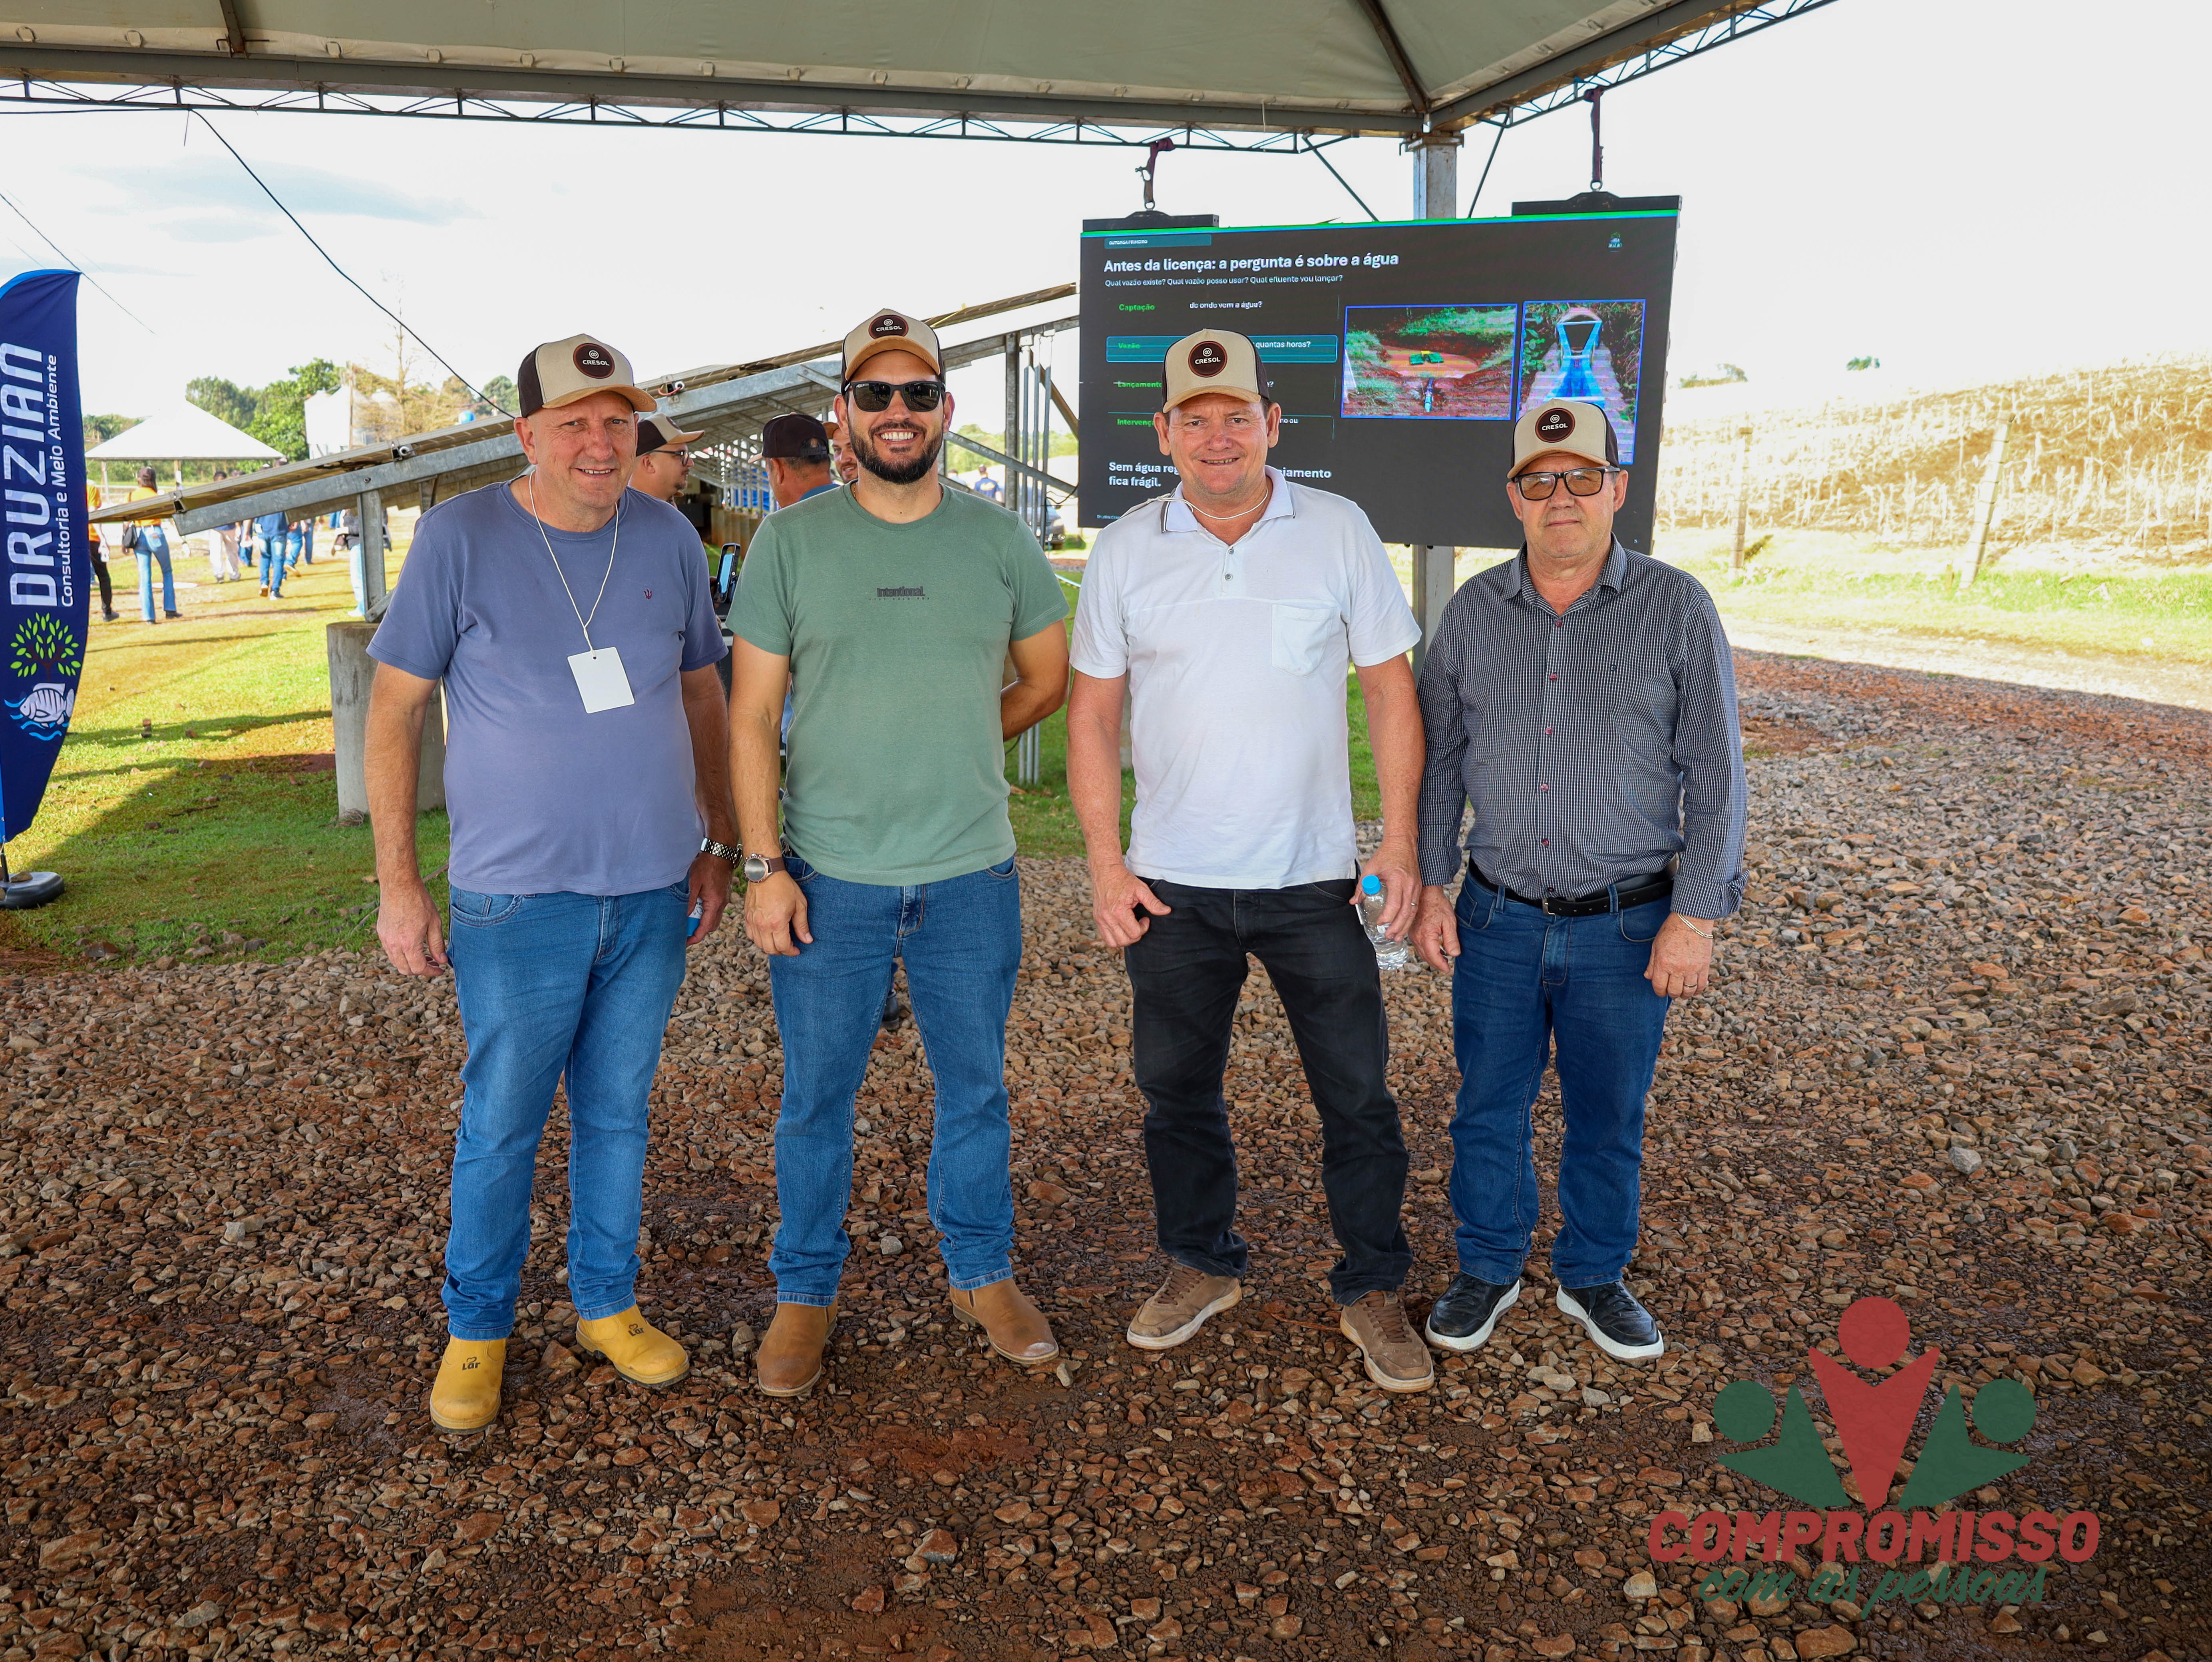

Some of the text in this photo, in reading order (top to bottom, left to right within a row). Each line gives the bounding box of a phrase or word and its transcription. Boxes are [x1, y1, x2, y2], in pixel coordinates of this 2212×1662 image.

[1104, 252, 1399, 272] Antes da licença: a pergunta é sobre a água
[1122, 278, 1142, 286] vazão
[1315, 274, 1343, 283] lançar?
[1118, 303, 1156, 312] Captação
[1240, 300, 1262, 310] água?
[0, 342, 58, 606] DRUZIAN
[1108, 462, 1133, 472] Sem
[1135, 462, 1161, 474] água
[1279, 467, 1332, 479] iamento
[46, 354, 74, 607] Consultoria e Meio Ambiente
[1108, 475, 1162, 489] fica frágil.
[462, 1362, 481, 1371] Lar
